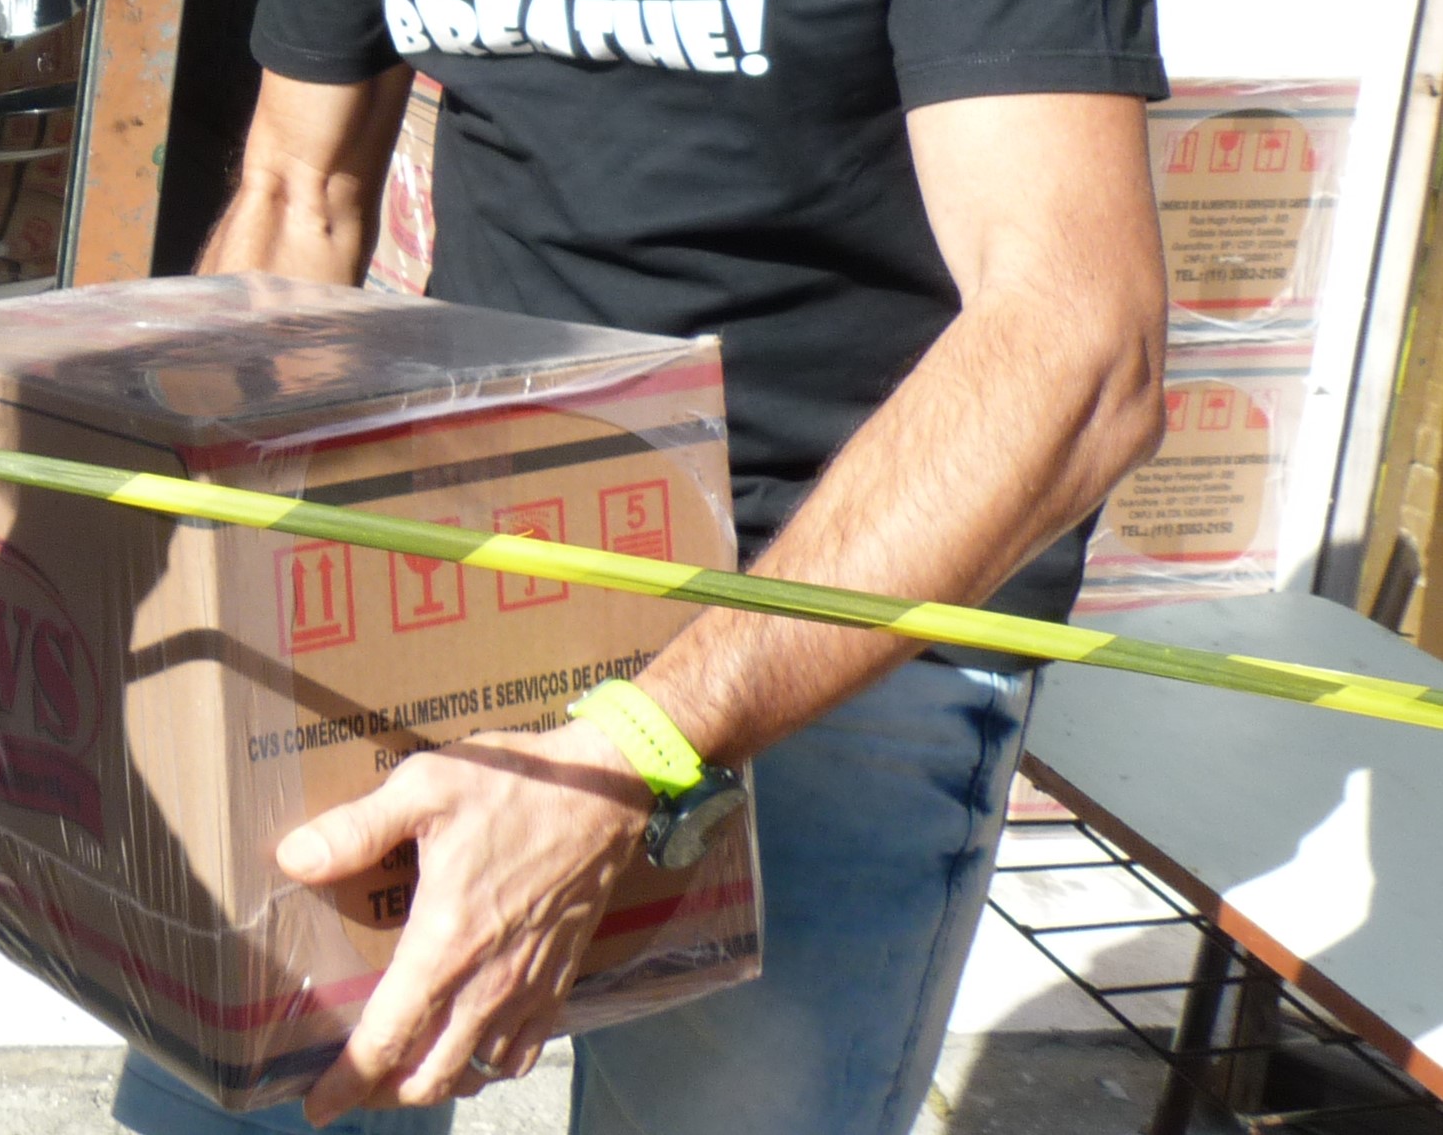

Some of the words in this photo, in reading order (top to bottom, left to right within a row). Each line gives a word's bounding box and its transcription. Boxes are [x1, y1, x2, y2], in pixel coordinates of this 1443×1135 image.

[626, 493, 647, 530] 5
[248, 732, 282, 762] CVS
[284, 714, 365, 755] COMÉRCIO
[369, 709, 390, 737] DE
[392, 687, 480, 732] ALIMENTOS
[482, 682, 493, 712] E
[496, 668, 568, 708] SERVIÇOS
[572, 664, 592, 692] DE
[594, 648, 660, 685] CARTÕE
